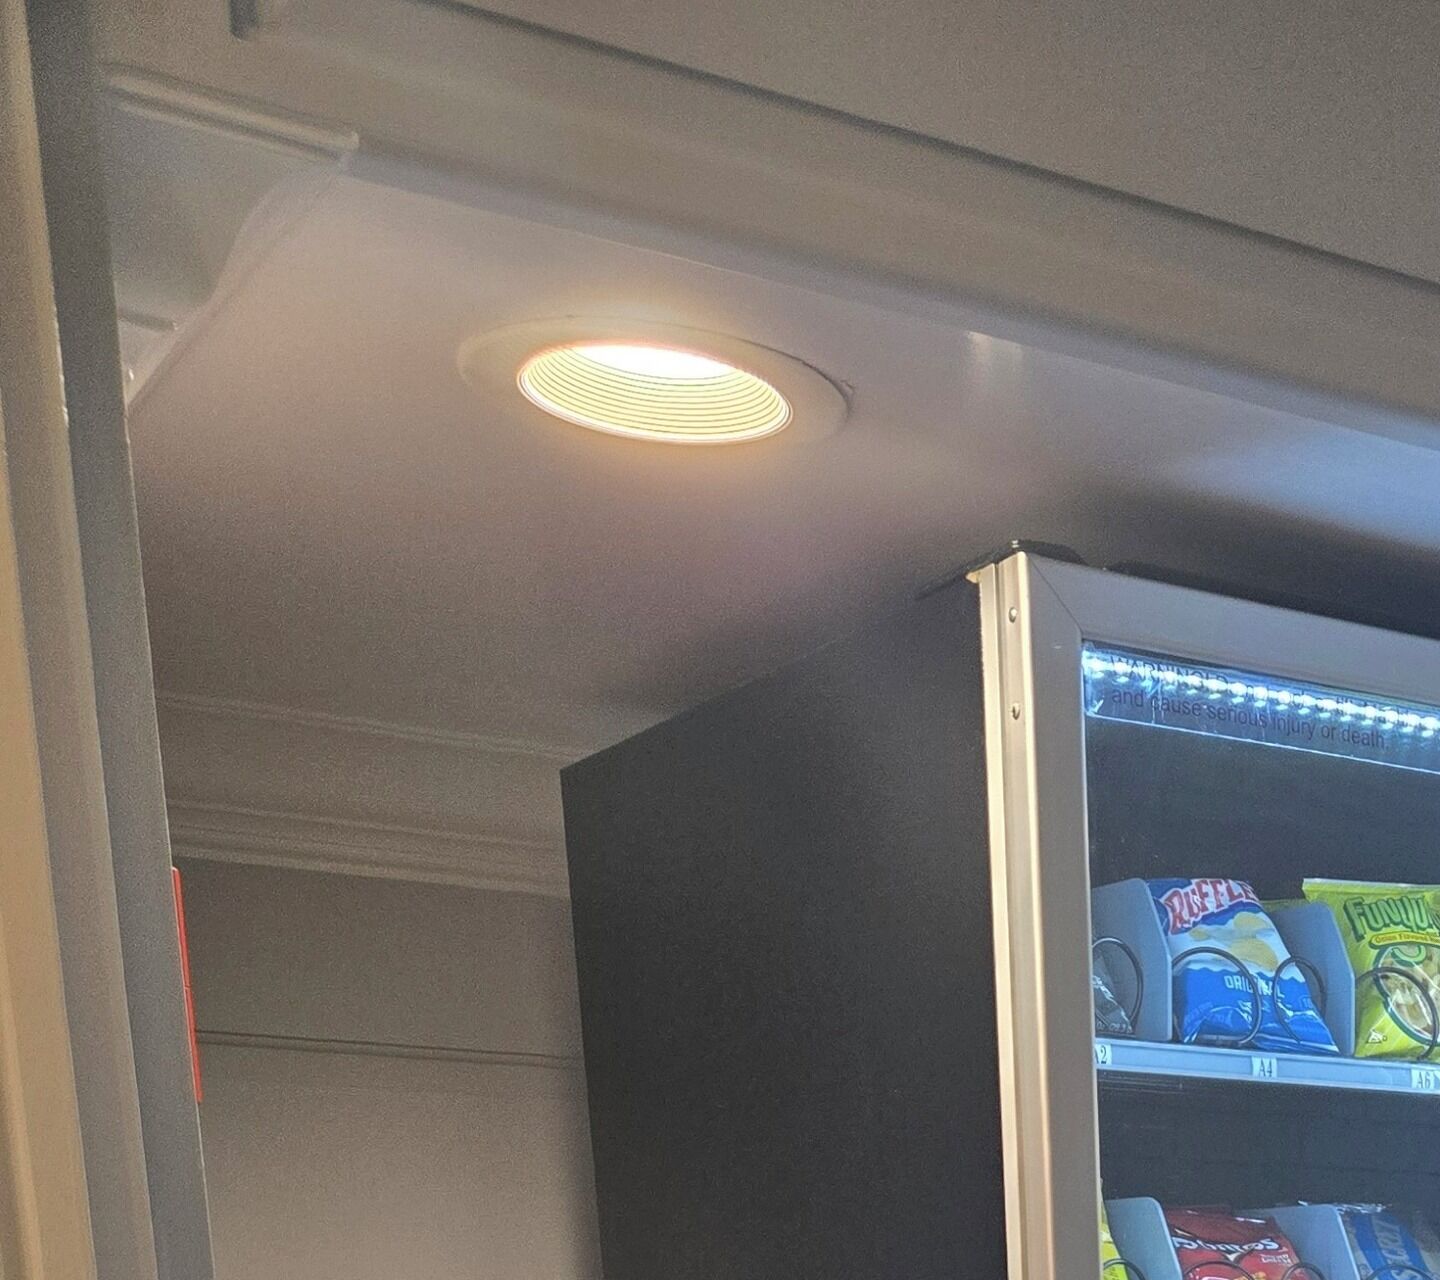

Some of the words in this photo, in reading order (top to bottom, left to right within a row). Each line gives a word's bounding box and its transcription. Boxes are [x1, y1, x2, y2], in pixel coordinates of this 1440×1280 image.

[1112, 688, 1144, 707] and
[1151, 694, 1201, 716] cause
[1206, 703, 1267, 727] serious
[1271, 714, 1315, 742] injury
[1321, 725, 1336, 739] or
[1342, 727, 1389, 750] death.
[1258, 1059, 1273, 1077] A4
[1416, 1072, 1431, 1089] A6
